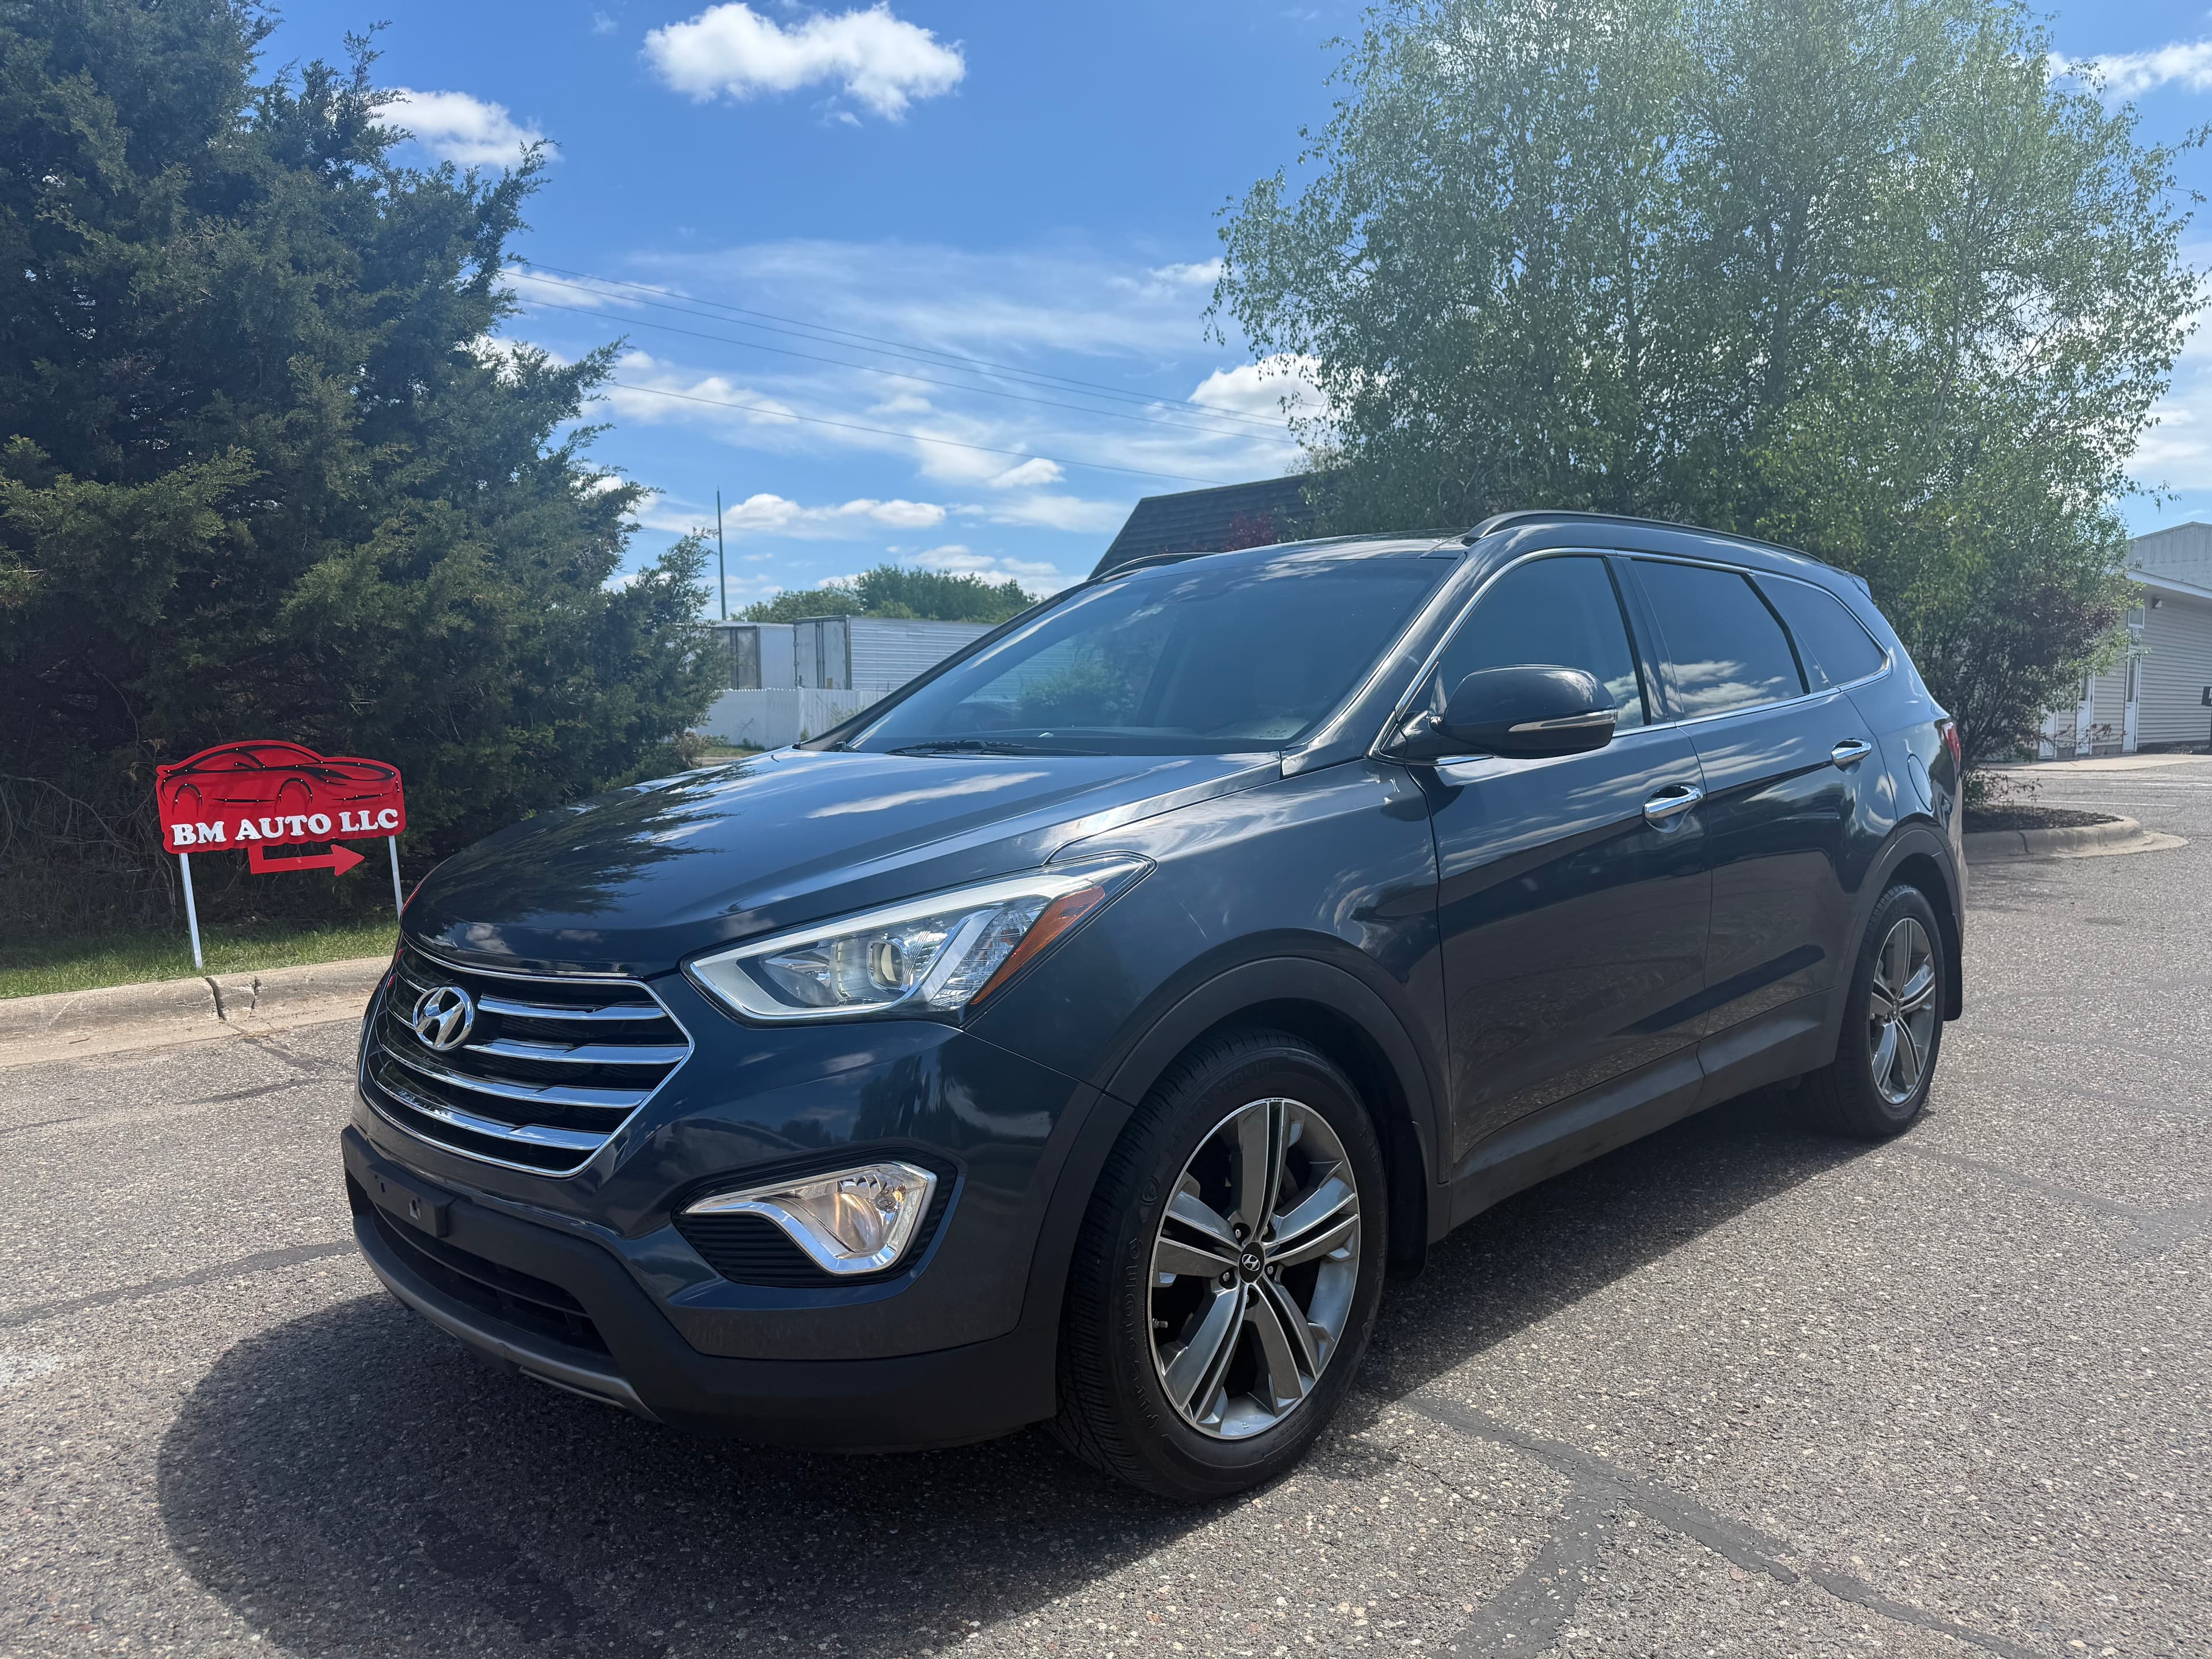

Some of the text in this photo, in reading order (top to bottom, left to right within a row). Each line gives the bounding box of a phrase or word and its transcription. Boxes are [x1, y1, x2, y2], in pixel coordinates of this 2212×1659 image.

[171, 809, 399, 845] BM AUTO LLC
